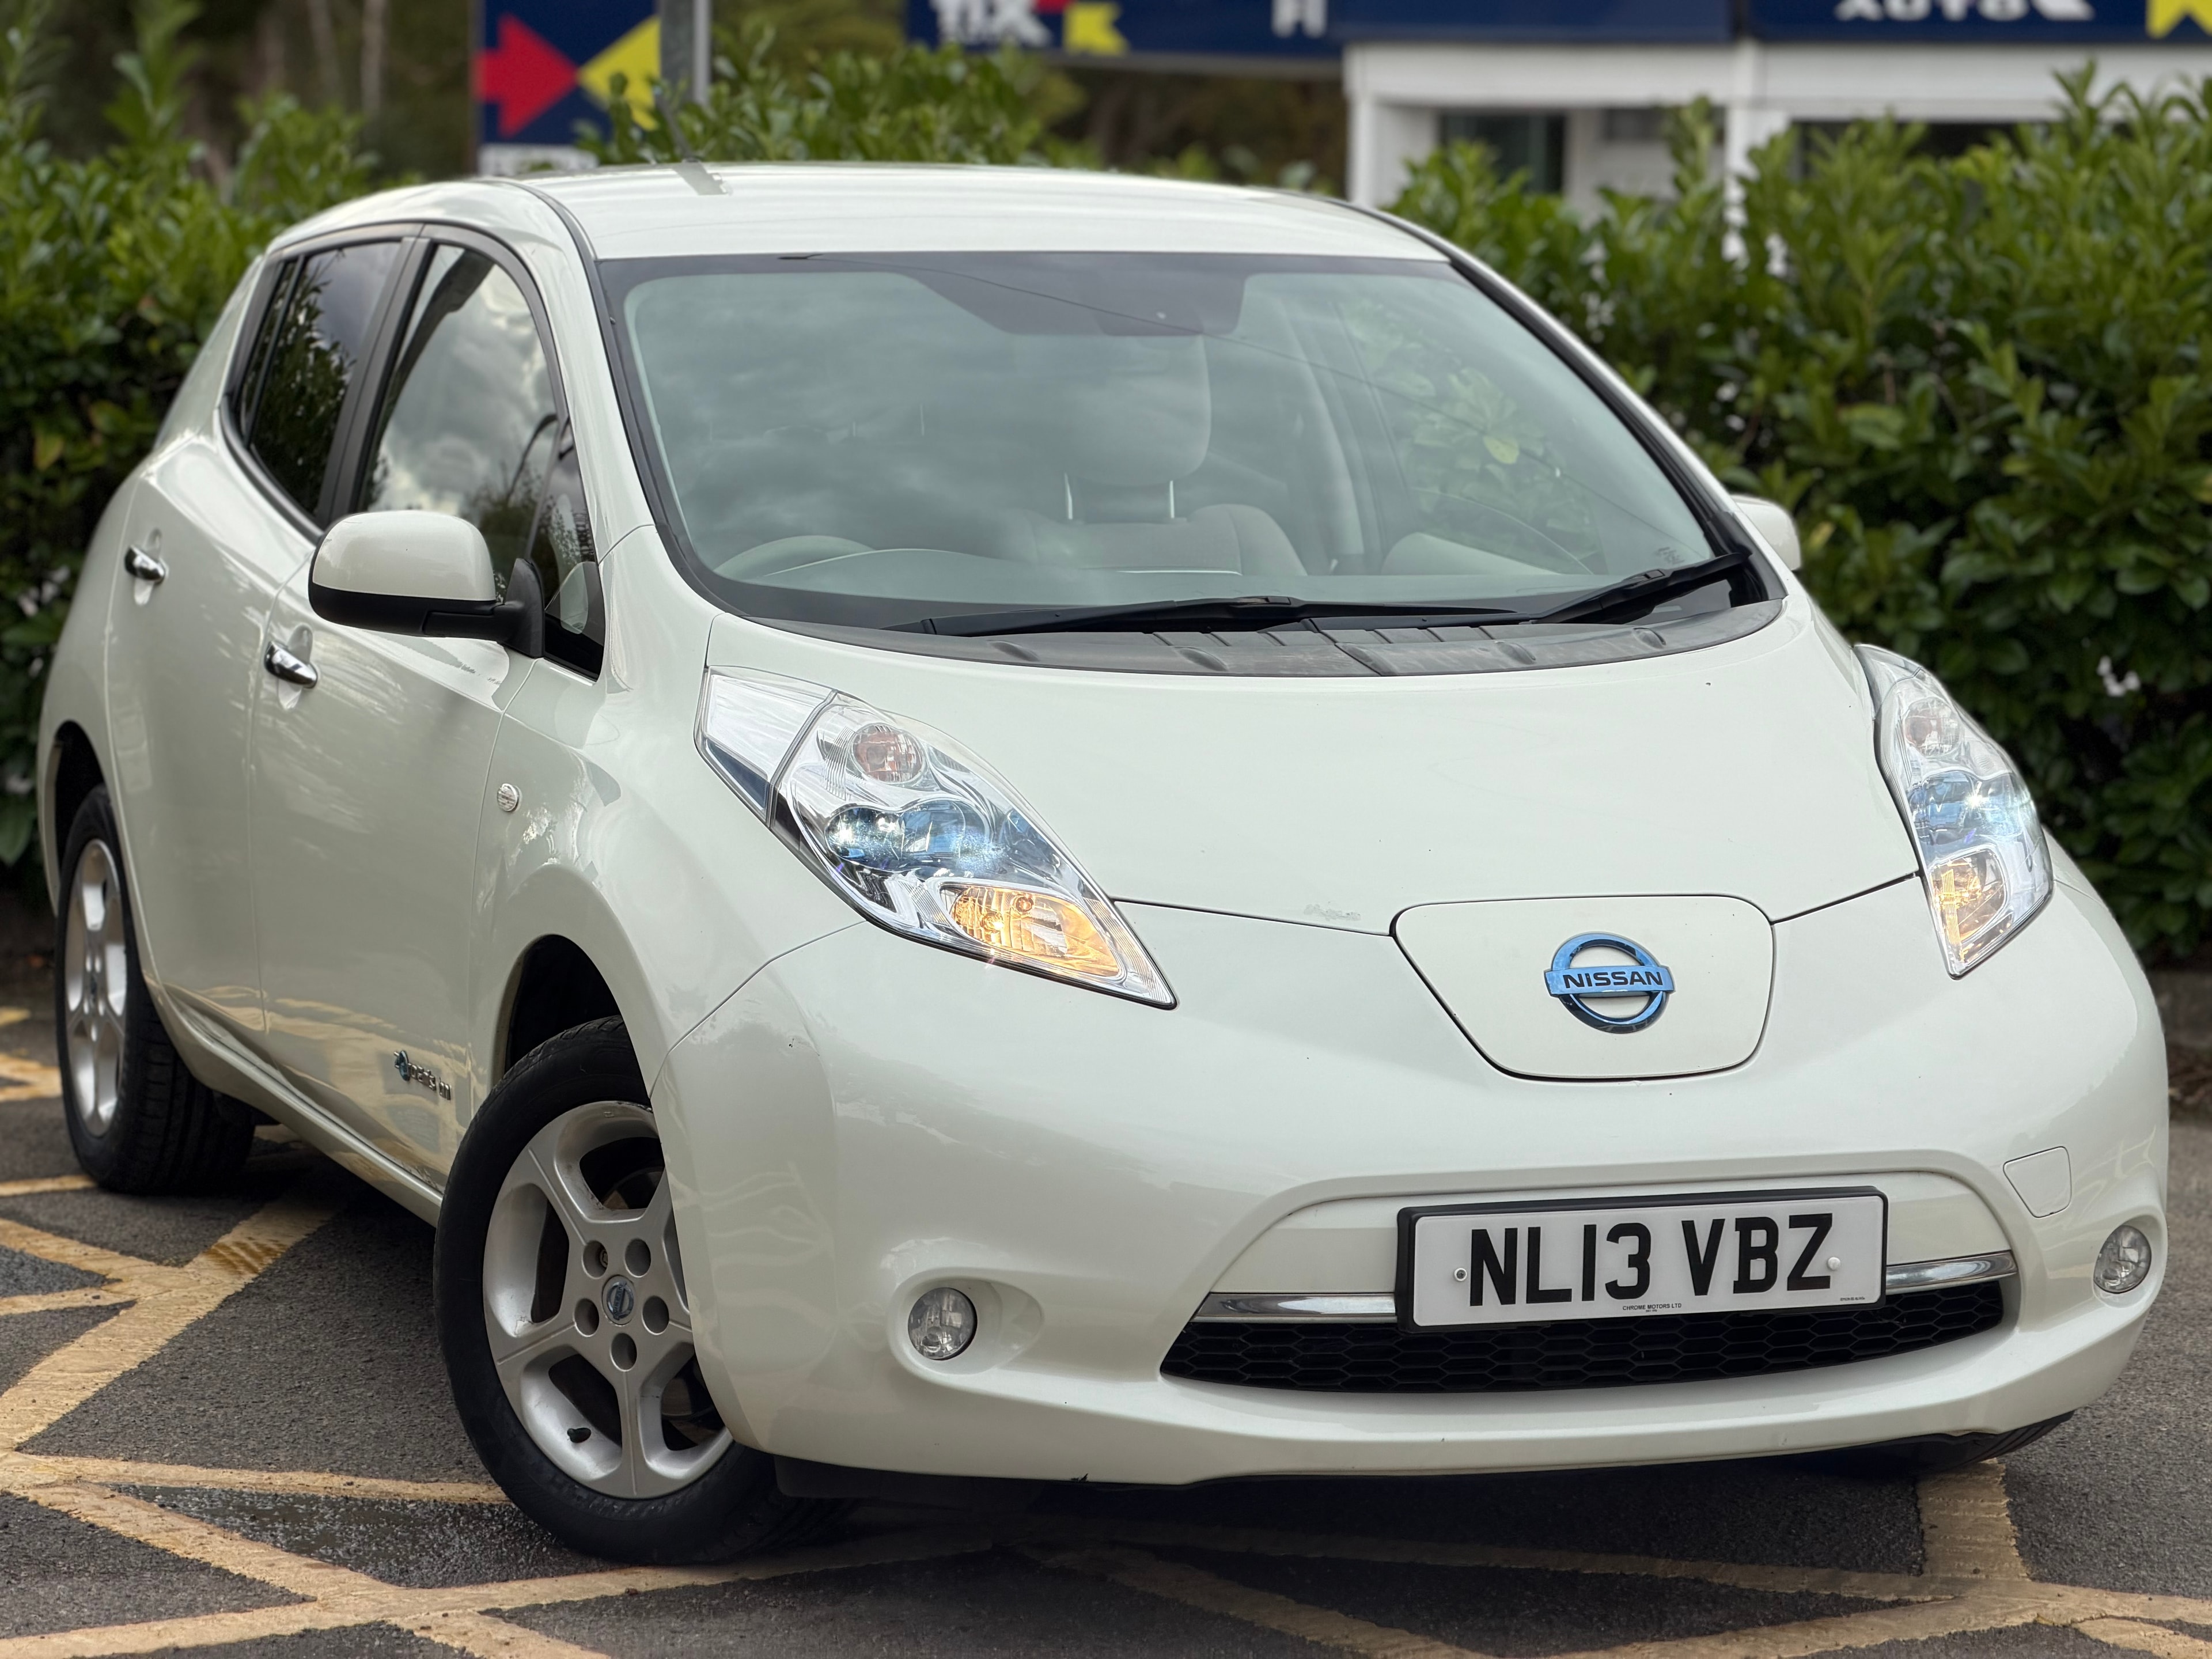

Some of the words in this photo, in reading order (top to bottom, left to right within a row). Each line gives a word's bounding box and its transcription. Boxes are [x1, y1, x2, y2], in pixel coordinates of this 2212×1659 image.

[1563, 971, 1663, 988] NISSAN
[1469, 1222, 1652, 1306] NL13
[1681, 1213, 1833, 1296] VBZ
